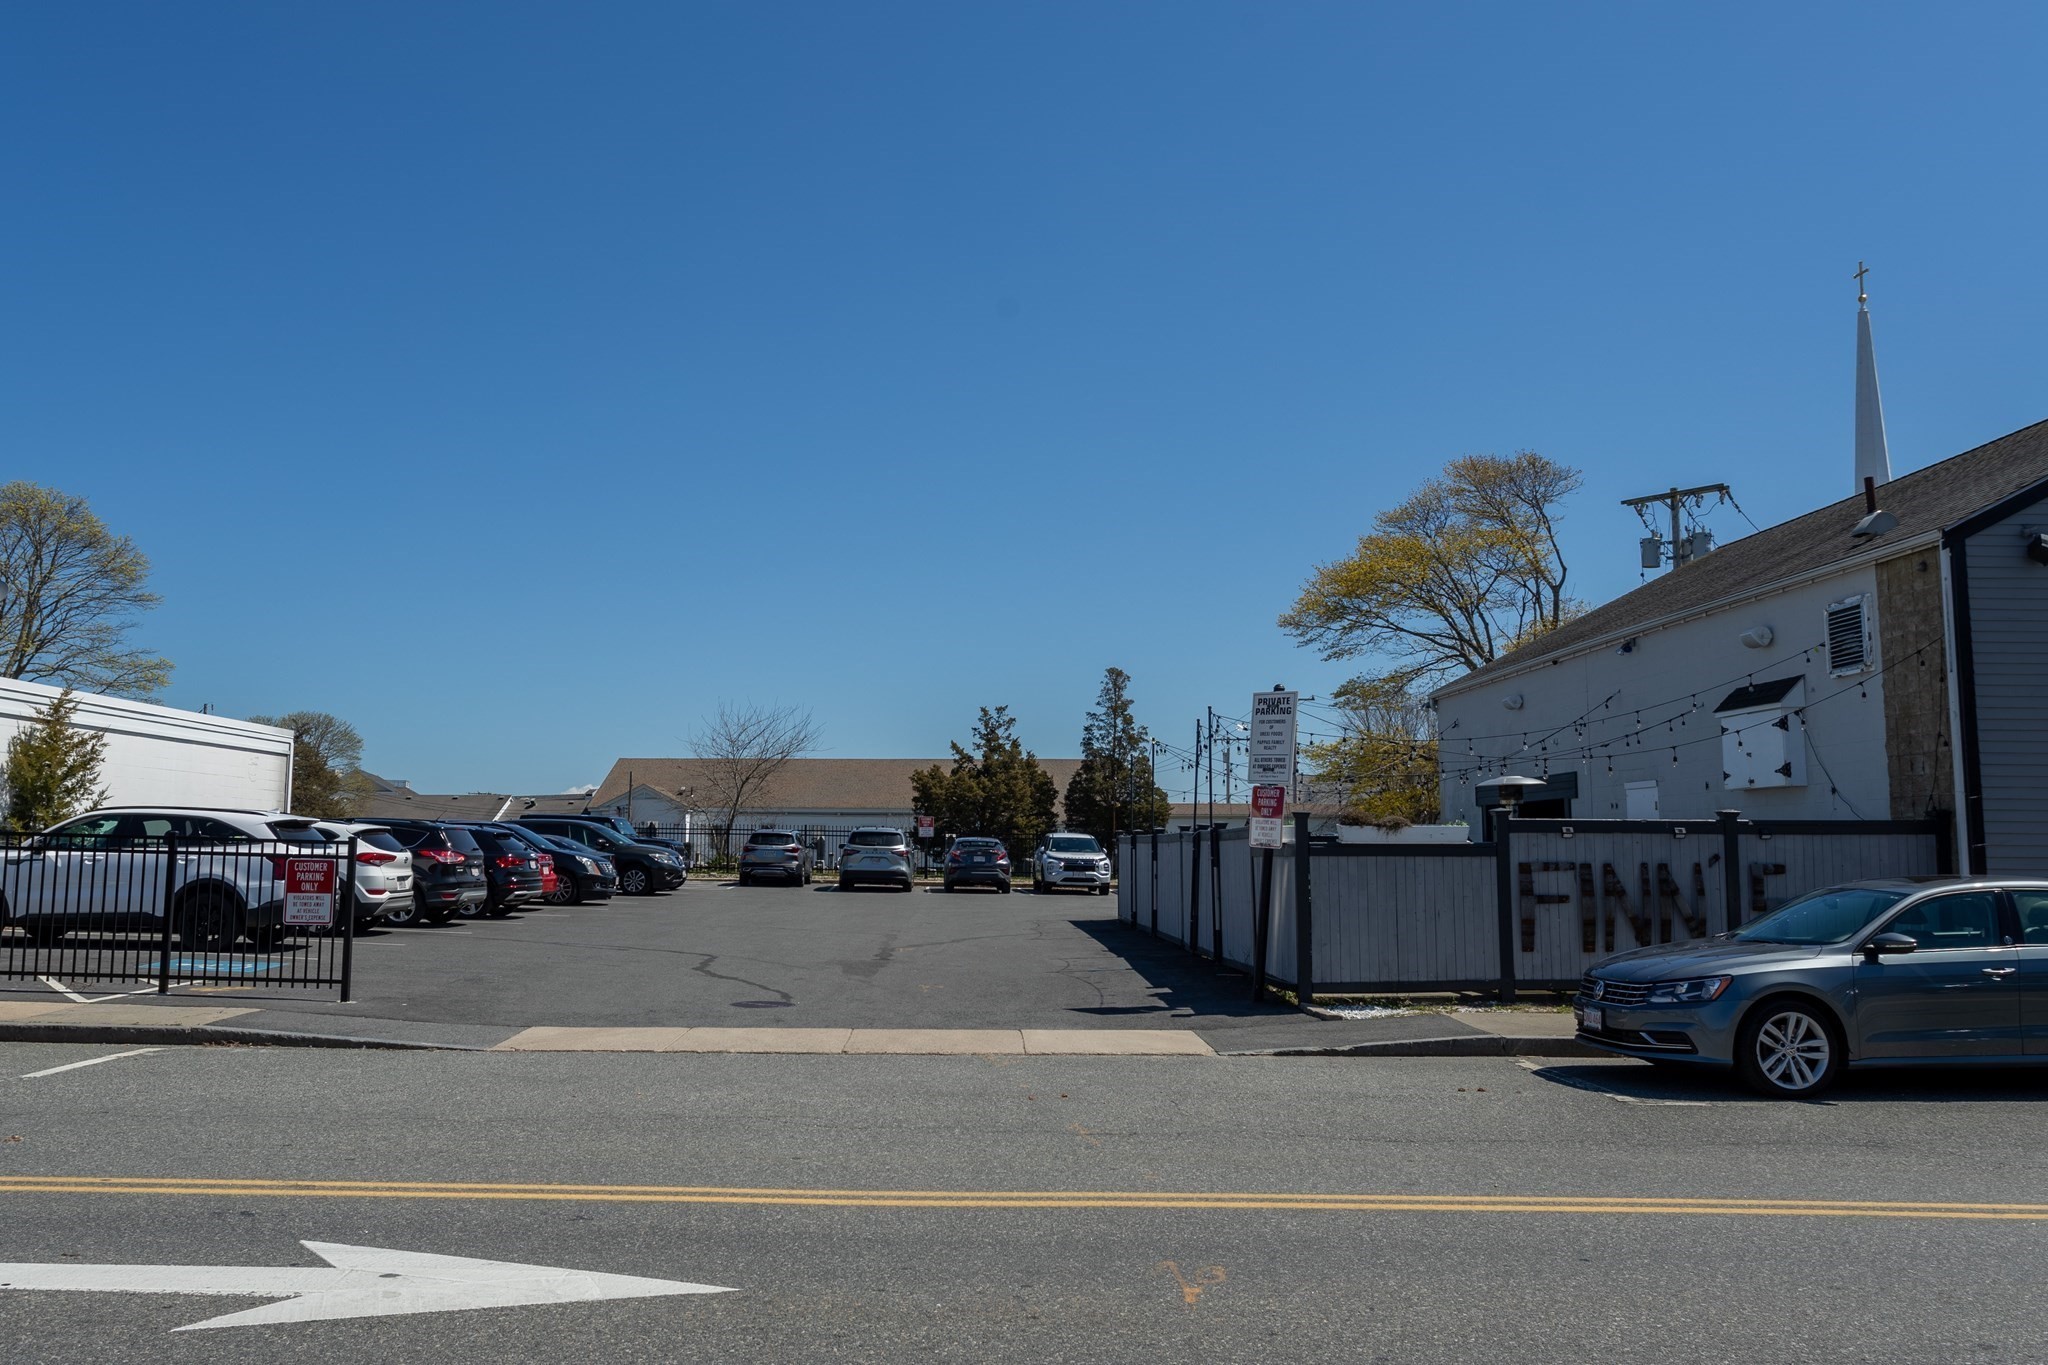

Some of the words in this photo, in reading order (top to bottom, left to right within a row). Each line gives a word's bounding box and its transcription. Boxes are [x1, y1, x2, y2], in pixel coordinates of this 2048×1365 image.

[1258, 697, 1290, 706] PRIVATE
[1256, 707, 1292, 716] PARKING
[1257, 789, 1280, 797] CUSTOMER
[1258, 798, 1277, 806] PARKING
[294, 862, 328, 871] CUSTOMER
[297, 872, 324, 881] PARKING
